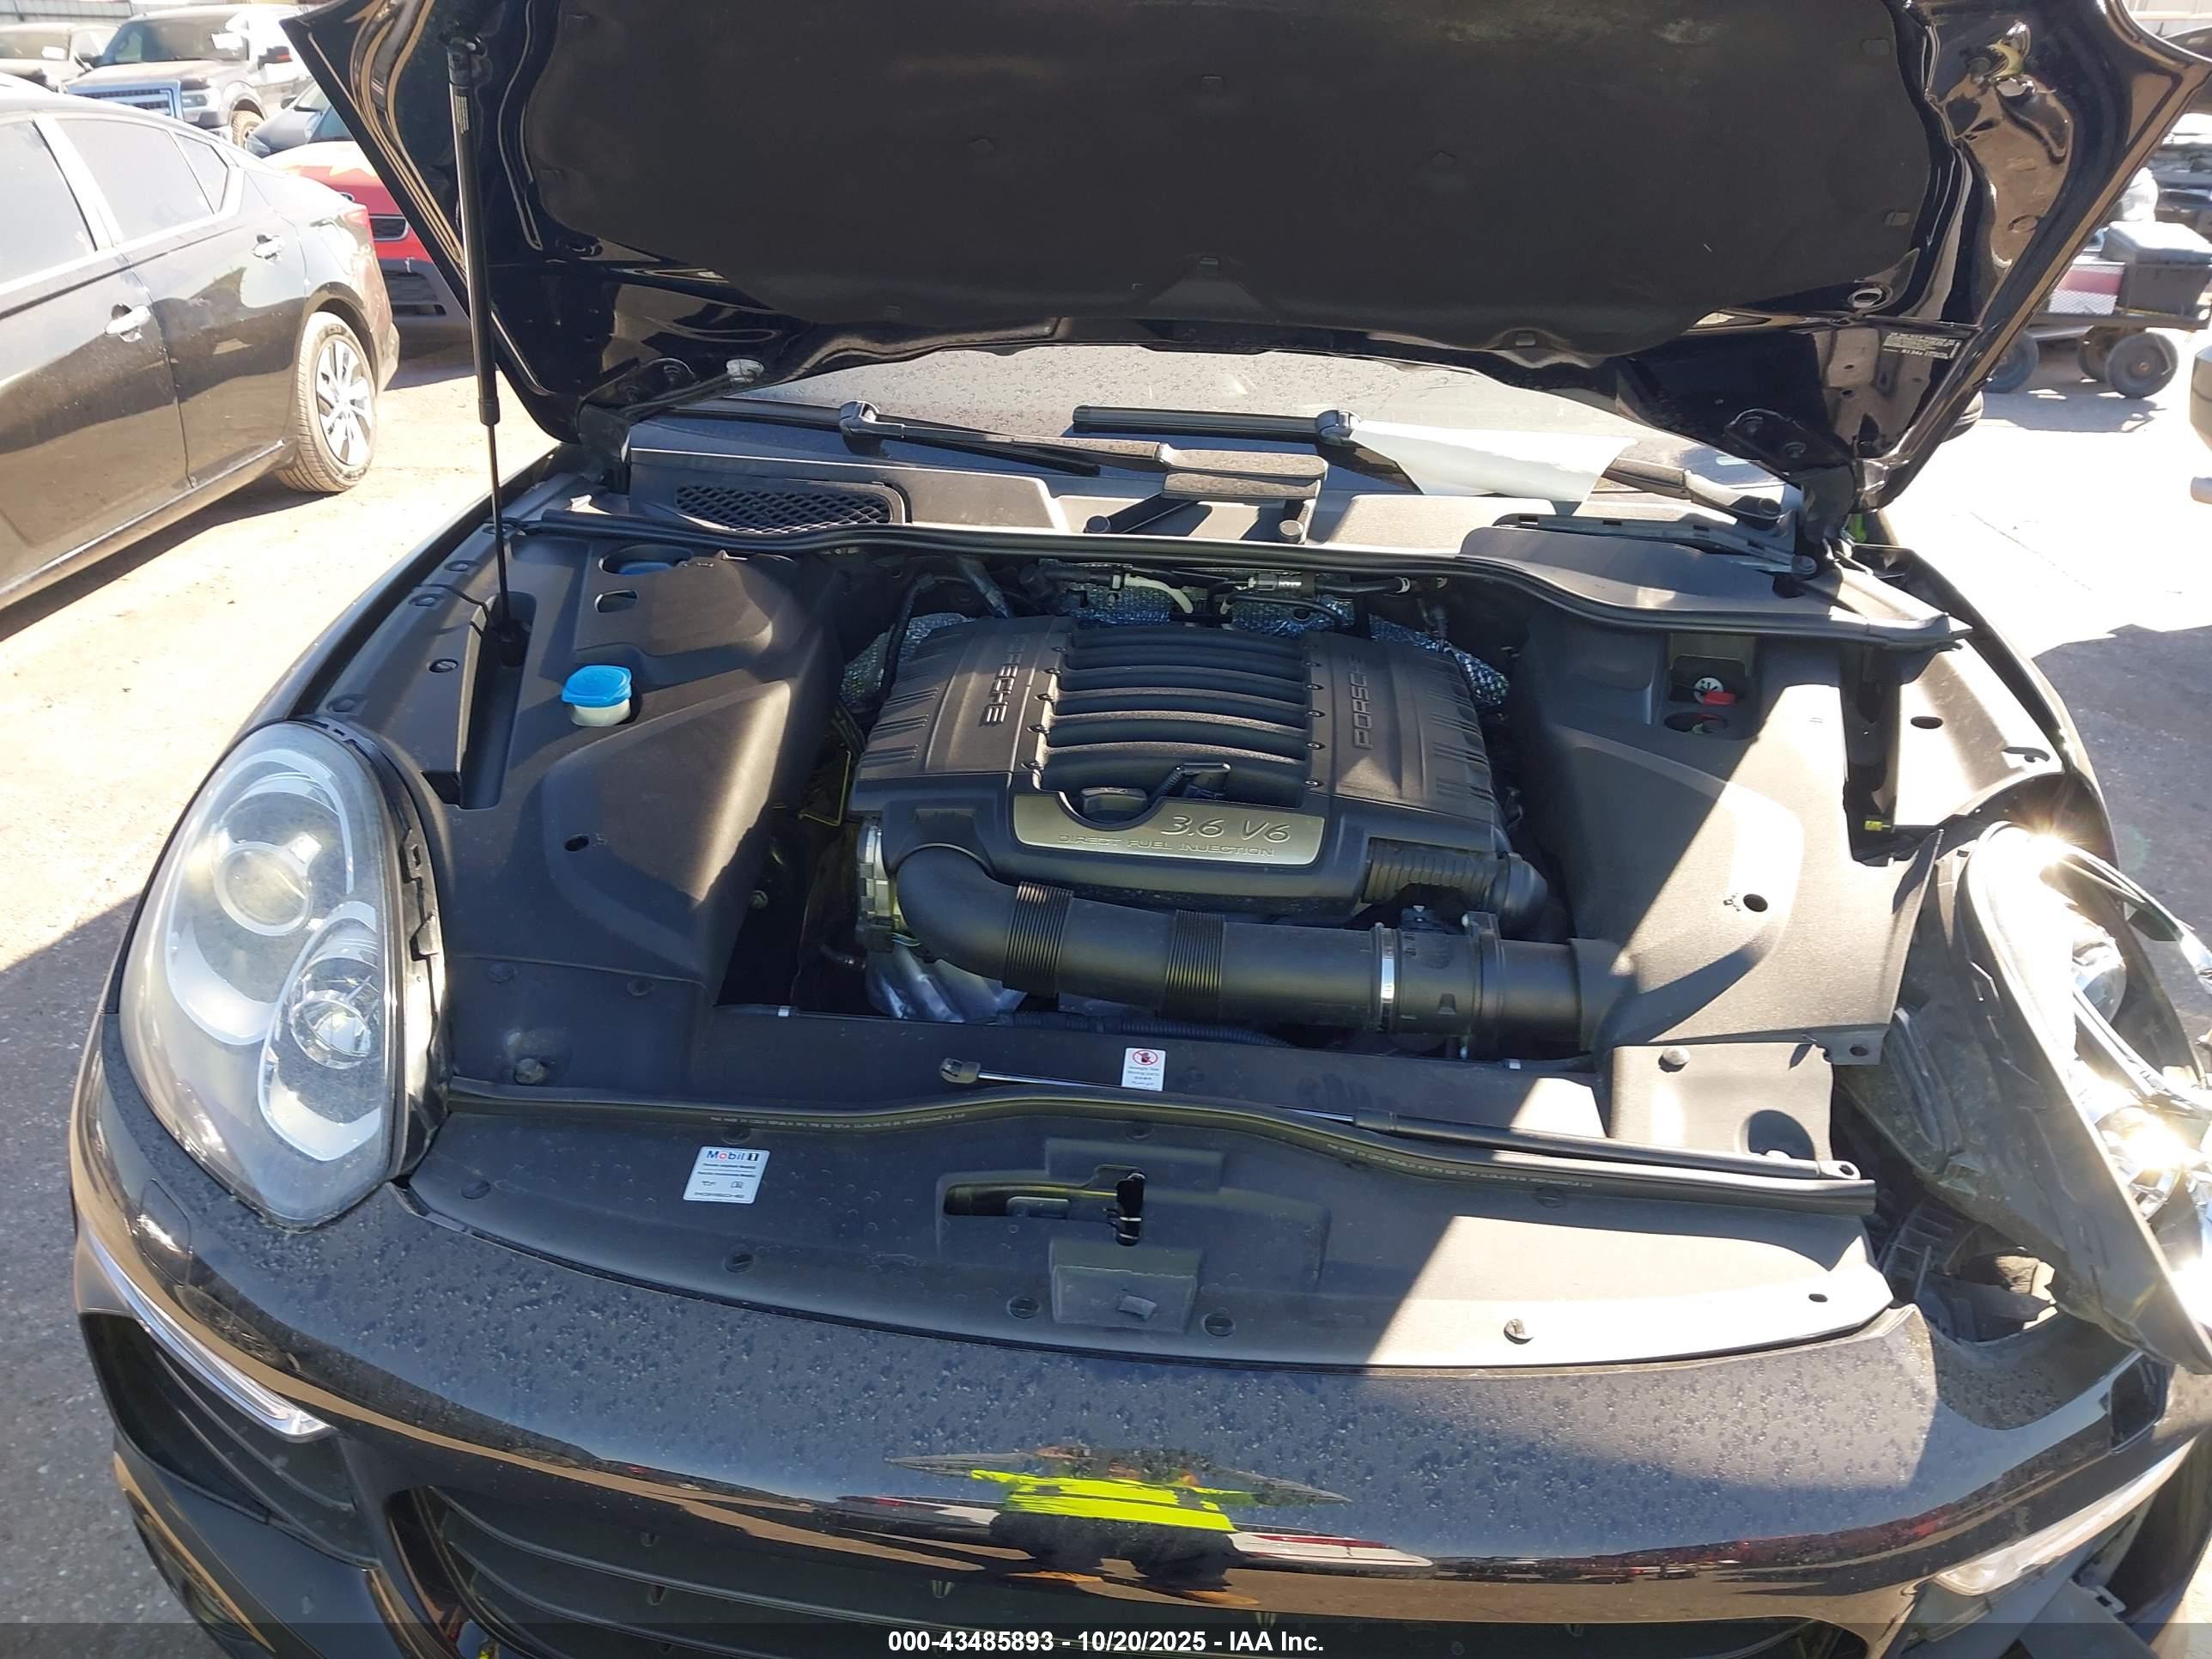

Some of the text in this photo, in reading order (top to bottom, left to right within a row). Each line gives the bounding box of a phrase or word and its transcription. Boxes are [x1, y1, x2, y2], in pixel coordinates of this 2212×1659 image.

[1160, 814, 1291, 843] 3.6 V6
[1057, 834, 1276, 857] DIRECT FUEL INJECTION
[706, 1150, 745, 1161] Mobil
